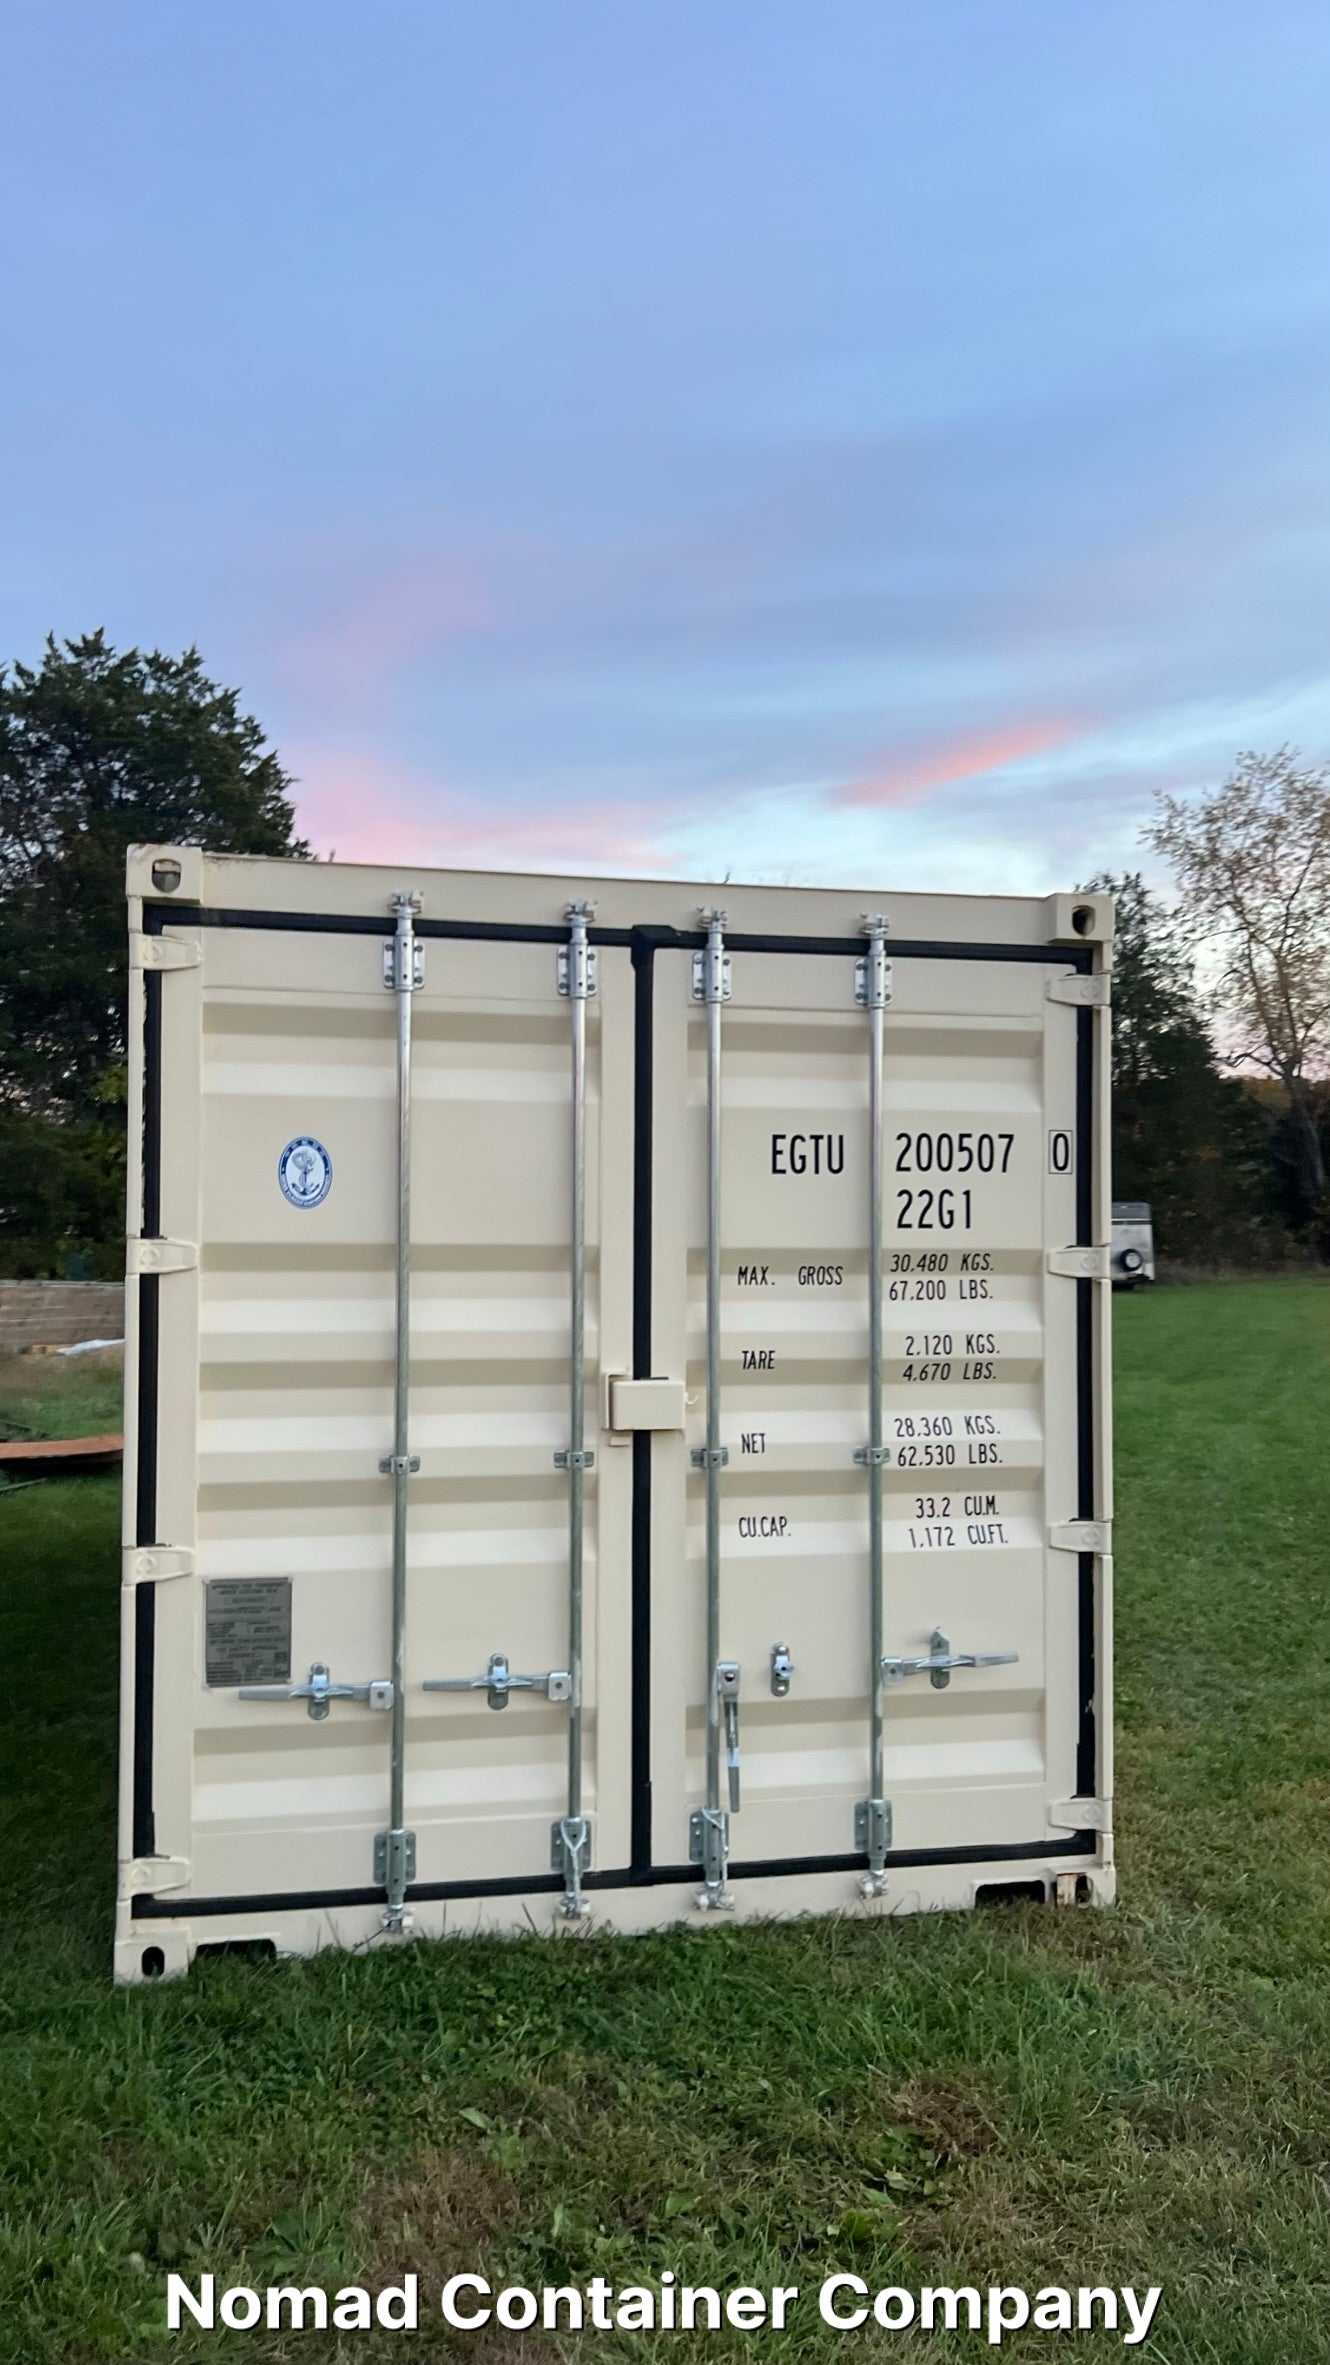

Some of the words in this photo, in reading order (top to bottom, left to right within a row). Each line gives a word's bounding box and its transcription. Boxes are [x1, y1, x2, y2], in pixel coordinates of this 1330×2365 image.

[772, 1134, 844, 1174] EGTU
[895, 1133, 1015, 1173] 200507
[1052, 1133, 1069, 1171] 0
[897, 1189, 971, 1229] 22G1
[961, 1253, 995, 1271] KGS.
[737, 1267, 776, 1286] MAX.
[798, 1266, 844, 1286] GROSS
[959, 1280, 994, 1300] LBS.
[966, 1334, 1000, 1354] KGS.
[742, 1350, 776, 1370] TARE
[963, 1362, 997, 1381] LBS.
[965, 1415, 1000, 1435] KGS.
[741, 1433, 766, 1454] NET
[968, 1444, 1003, 1465] LBS.
[915, 1497, 951, 1518] 33.2
[739, 1517, 791, 1538] CU.CAP.
